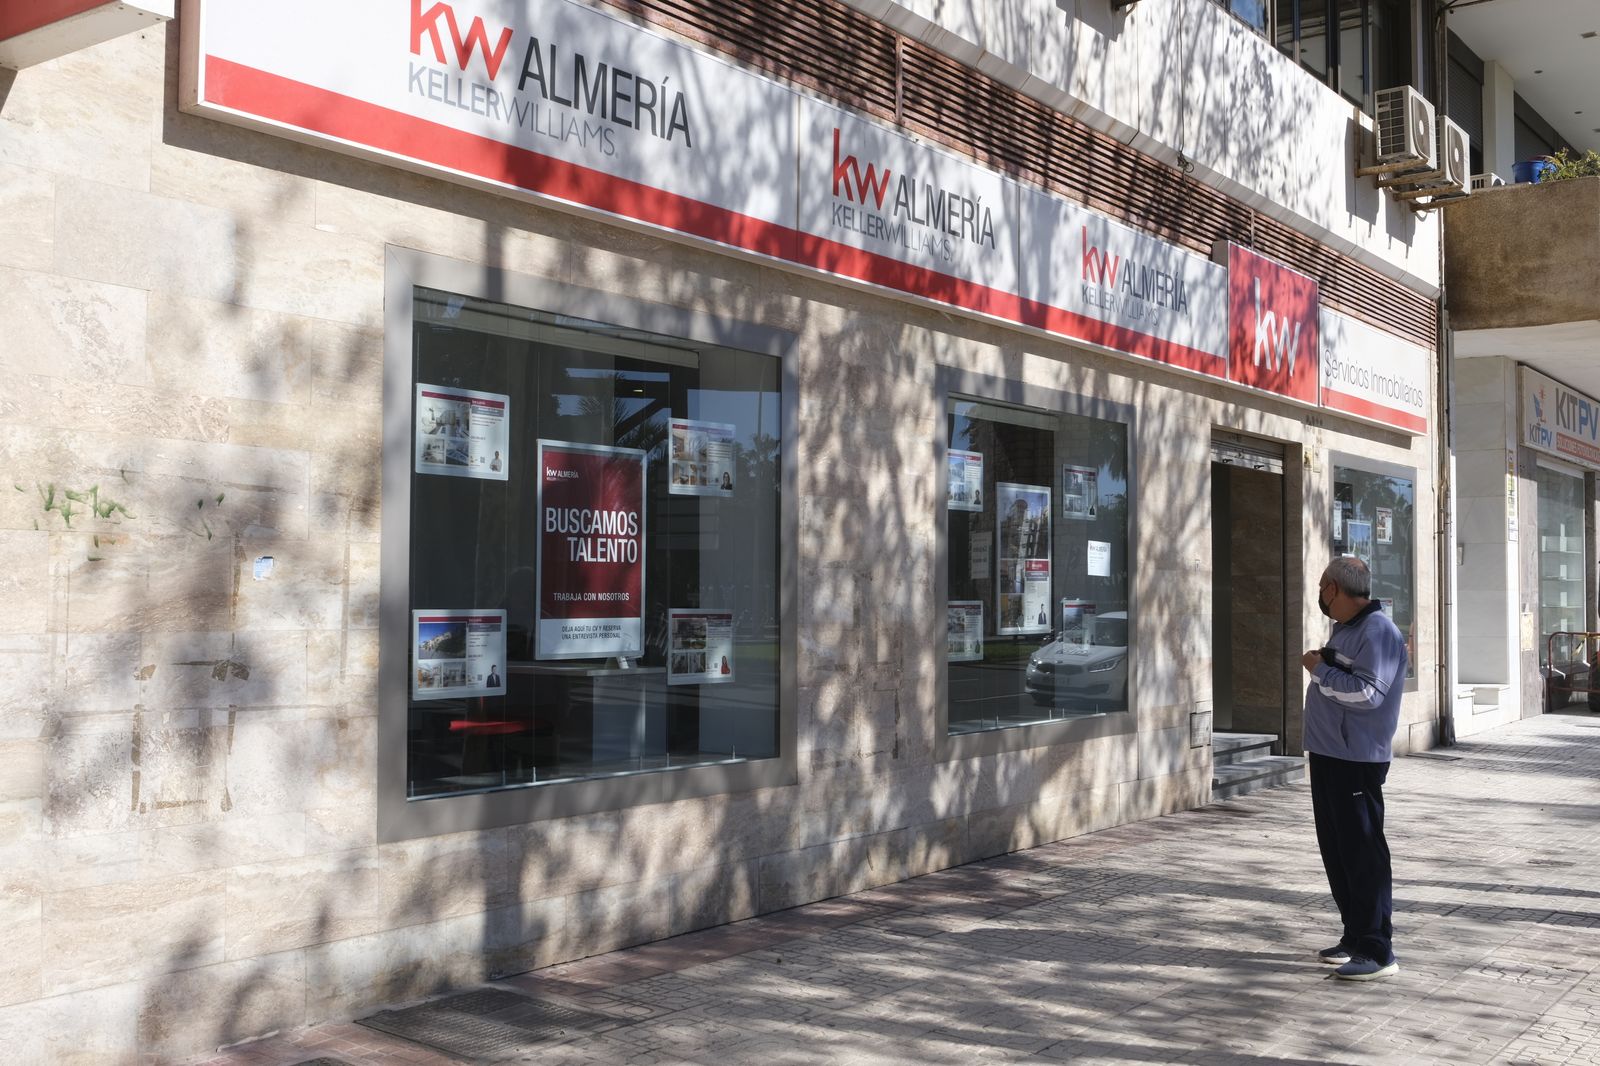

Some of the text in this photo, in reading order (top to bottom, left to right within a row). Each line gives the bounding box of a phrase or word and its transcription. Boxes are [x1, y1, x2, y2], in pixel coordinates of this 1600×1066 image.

[518, 36, 692, 148] ALMERÍA
[893, 174, 996, 249] ALMERÍA
[1121, 258, 1188, 314] ALMERÍA
[1324, 349, 1369, 389] Servicios
[1556, 388, 1599, 440] KITPV
[1529, 423, 1552, 447] KITPV
[546, 507, 638, 536] BUSCAMOS
[567, 537, 638, 563] TALENTO
[553, 592, 630, 601] TRABAJA CON NOSOTROS
[572, 632, 598, 640] ENTREVISTA
